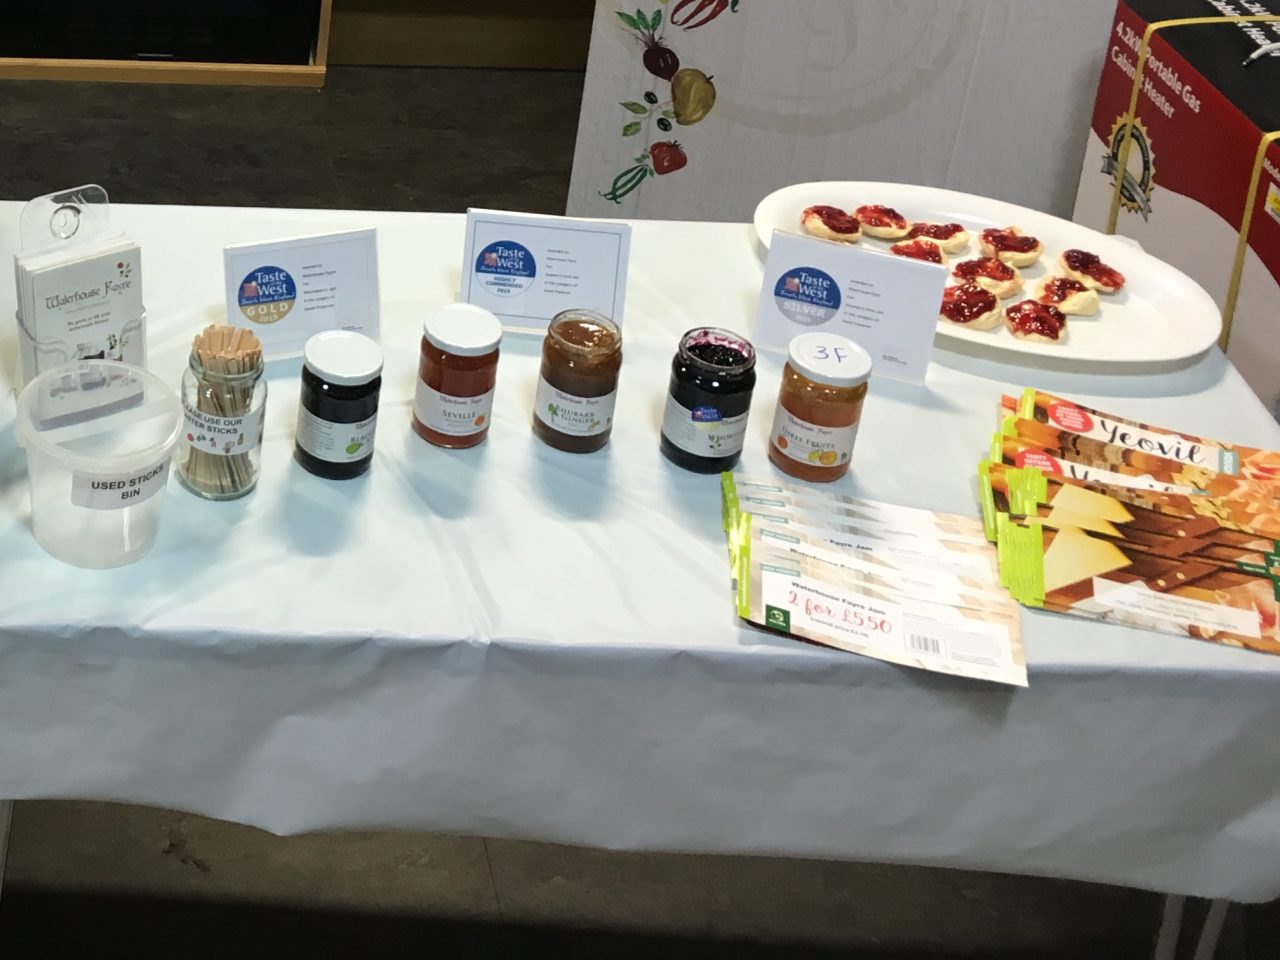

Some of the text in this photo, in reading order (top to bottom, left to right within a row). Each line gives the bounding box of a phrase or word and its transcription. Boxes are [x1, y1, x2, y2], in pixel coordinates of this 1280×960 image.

[1111, 45, 1176, 119] Cabint Heater
[1182, 85, 1201, 113] Gas
[495, 245, 525, 259] Taste
[497, 257, 524, 269] West
[255, 271, 287, 284] Taste
[799, 271, 830, 288] Taste
[257, 284, 288, 296] West
[798, 283, 828, 298] West
[247, 302, 289, 316] GOLD
[783, 301, 826, 318] SILVER
[184, 412, 238, 434] ASTER STICKS
[204, 415, 221, 425] USE
[223, 418, 242, 426] OUR
[1101, 419, 1206, 465] Yeovil
[91, 463, 164, 490] USED STICKS
[121, 488, 140, 500] BIN
[788, 590, 799, 607] 2
[805, 598, 836, 617] for
